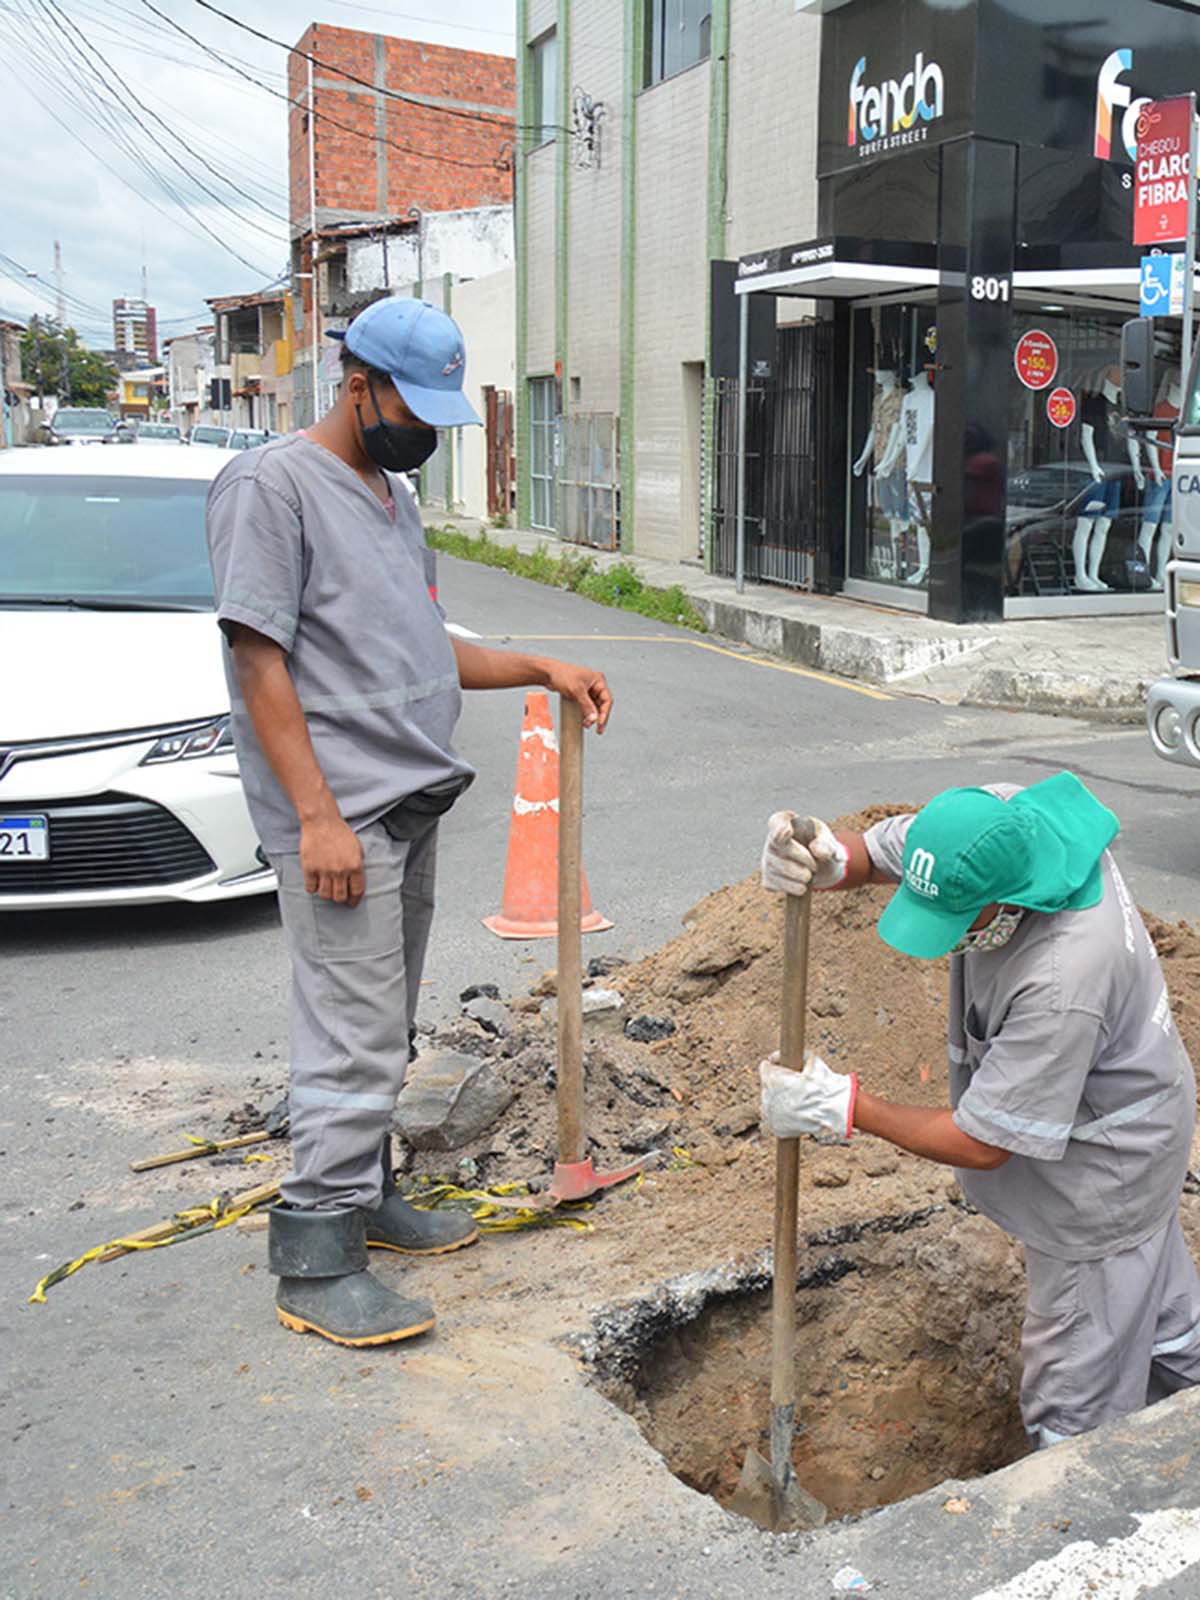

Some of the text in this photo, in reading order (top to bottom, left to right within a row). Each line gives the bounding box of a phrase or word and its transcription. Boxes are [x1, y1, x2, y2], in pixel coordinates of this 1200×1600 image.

[847, 51, 944, 147] fenda
[1138, 178, 1188, 208] FIBRA
[971, 276, 1010, 302] 801
